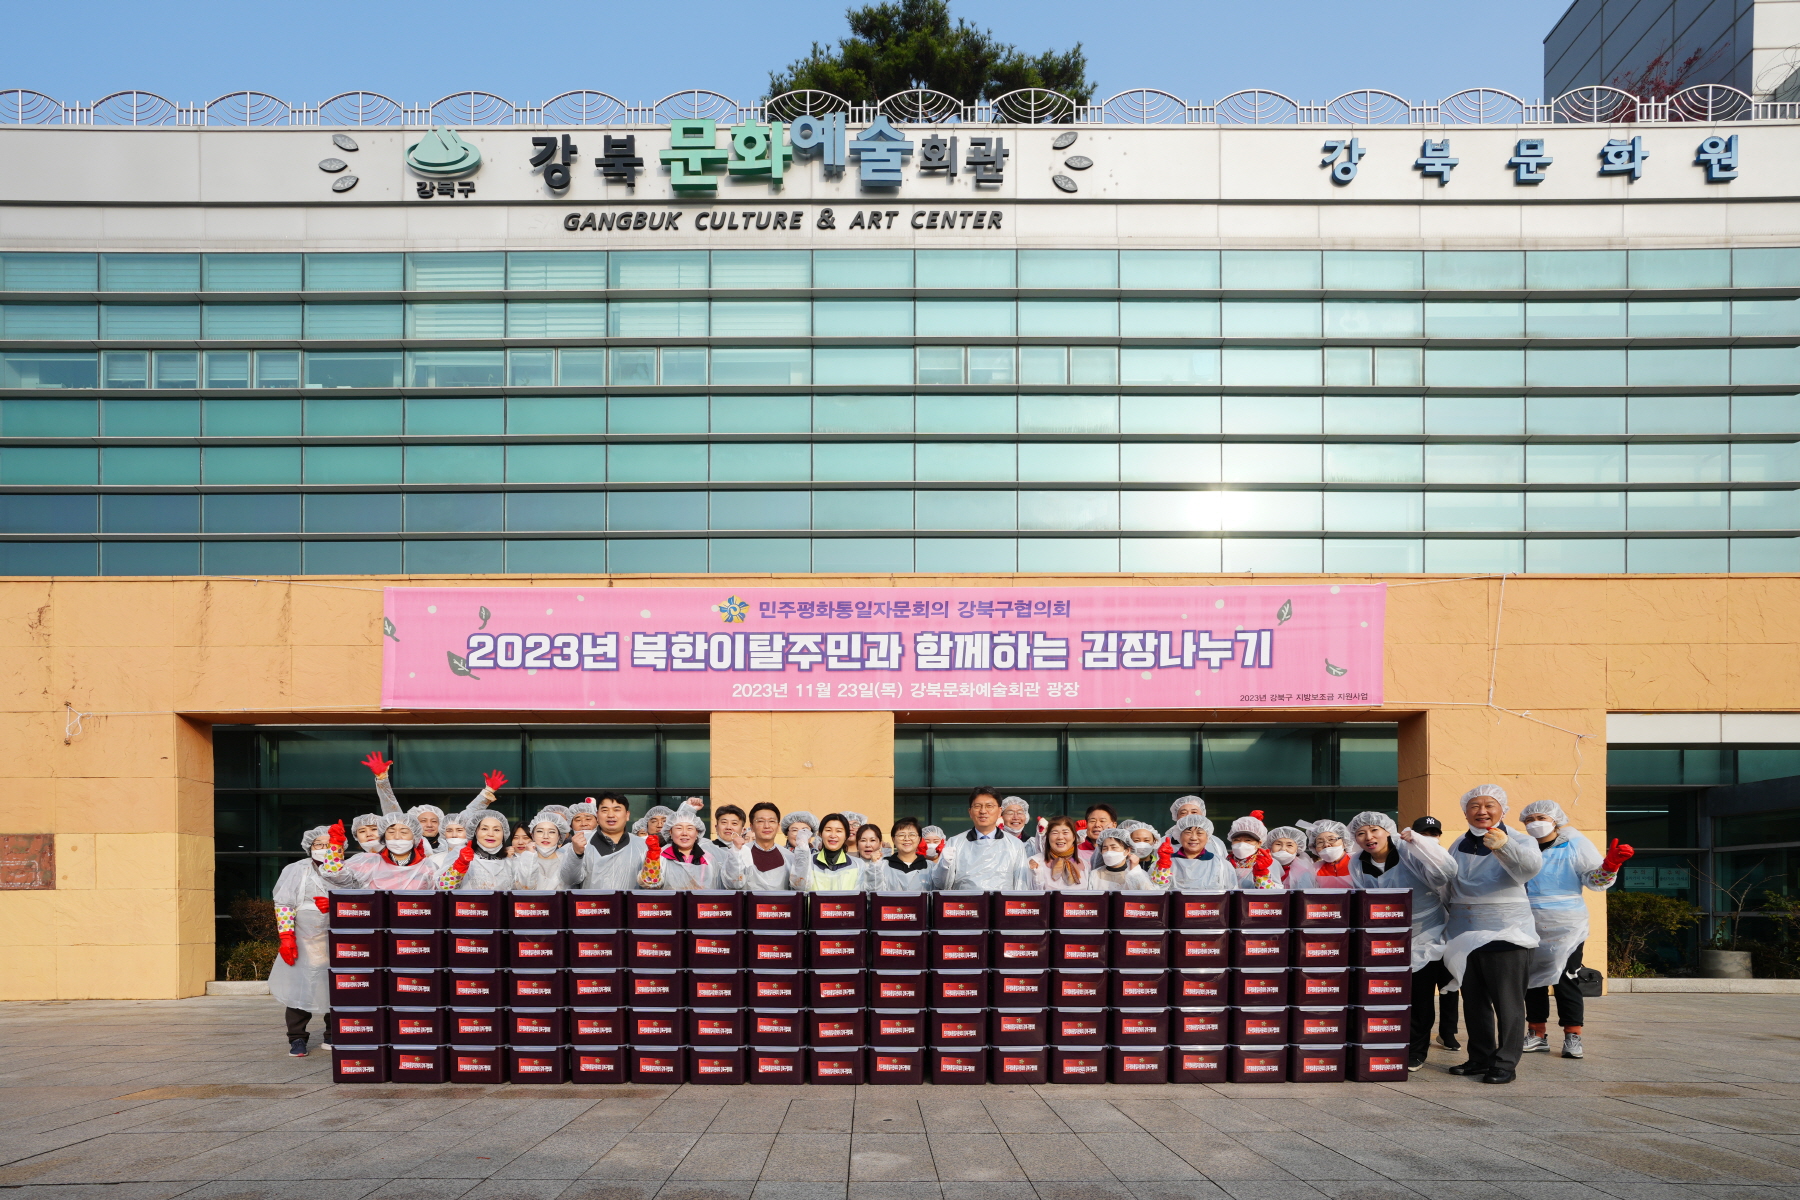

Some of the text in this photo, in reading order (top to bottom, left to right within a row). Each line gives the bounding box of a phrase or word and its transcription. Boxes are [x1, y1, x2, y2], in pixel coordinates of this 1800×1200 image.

[416, 181, 476, 198] 강북구
[563, 208, 1003, 231] GANGBUK CULTURE & ART CENTER
[758, 600, 1071, 619] 민주평화통일자문회의 강북구협의회
[467, 629, 1273, 671] 2023년 북한이탈주민과 함께하는 김장나누기
[732, 682, 1080, 699] 2023년 11월 23일(목) 강북문화예술회관 광장
[1239, 692, 1369, 702] 2023년 강북구 지방보조금 지원사업
